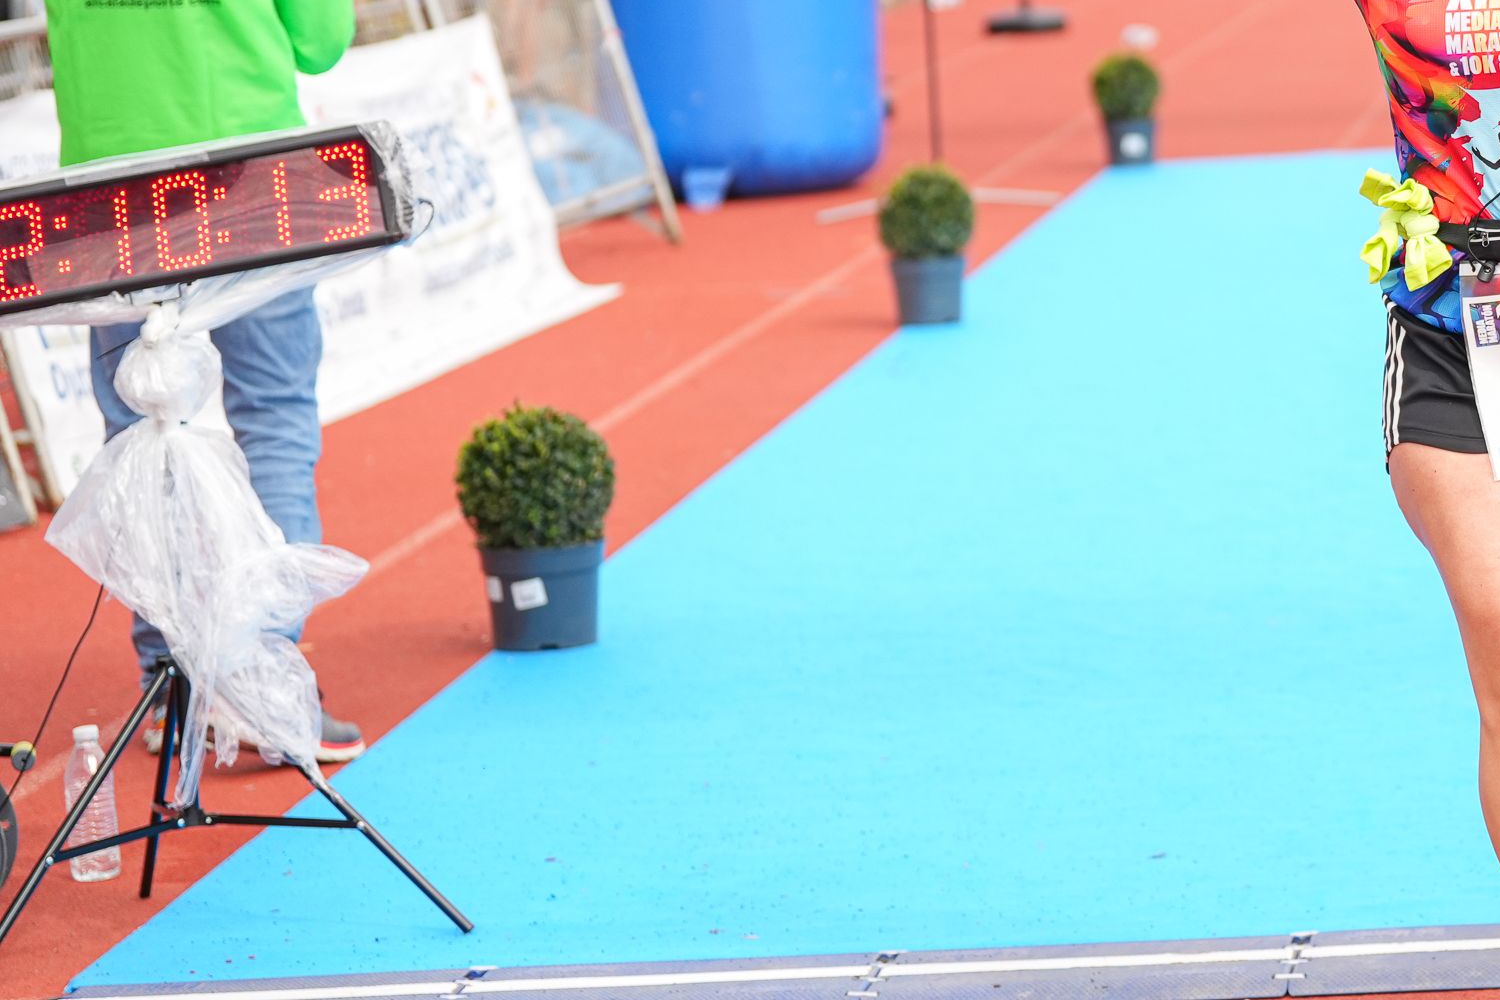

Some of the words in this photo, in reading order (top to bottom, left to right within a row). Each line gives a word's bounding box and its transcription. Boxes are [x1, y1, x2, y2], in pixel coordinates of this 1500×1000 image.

[1449, 62, 1460, 76] &
[1460, 54, 1496, 76] 10K
[0, 143, 371, 301] 2:10:13
